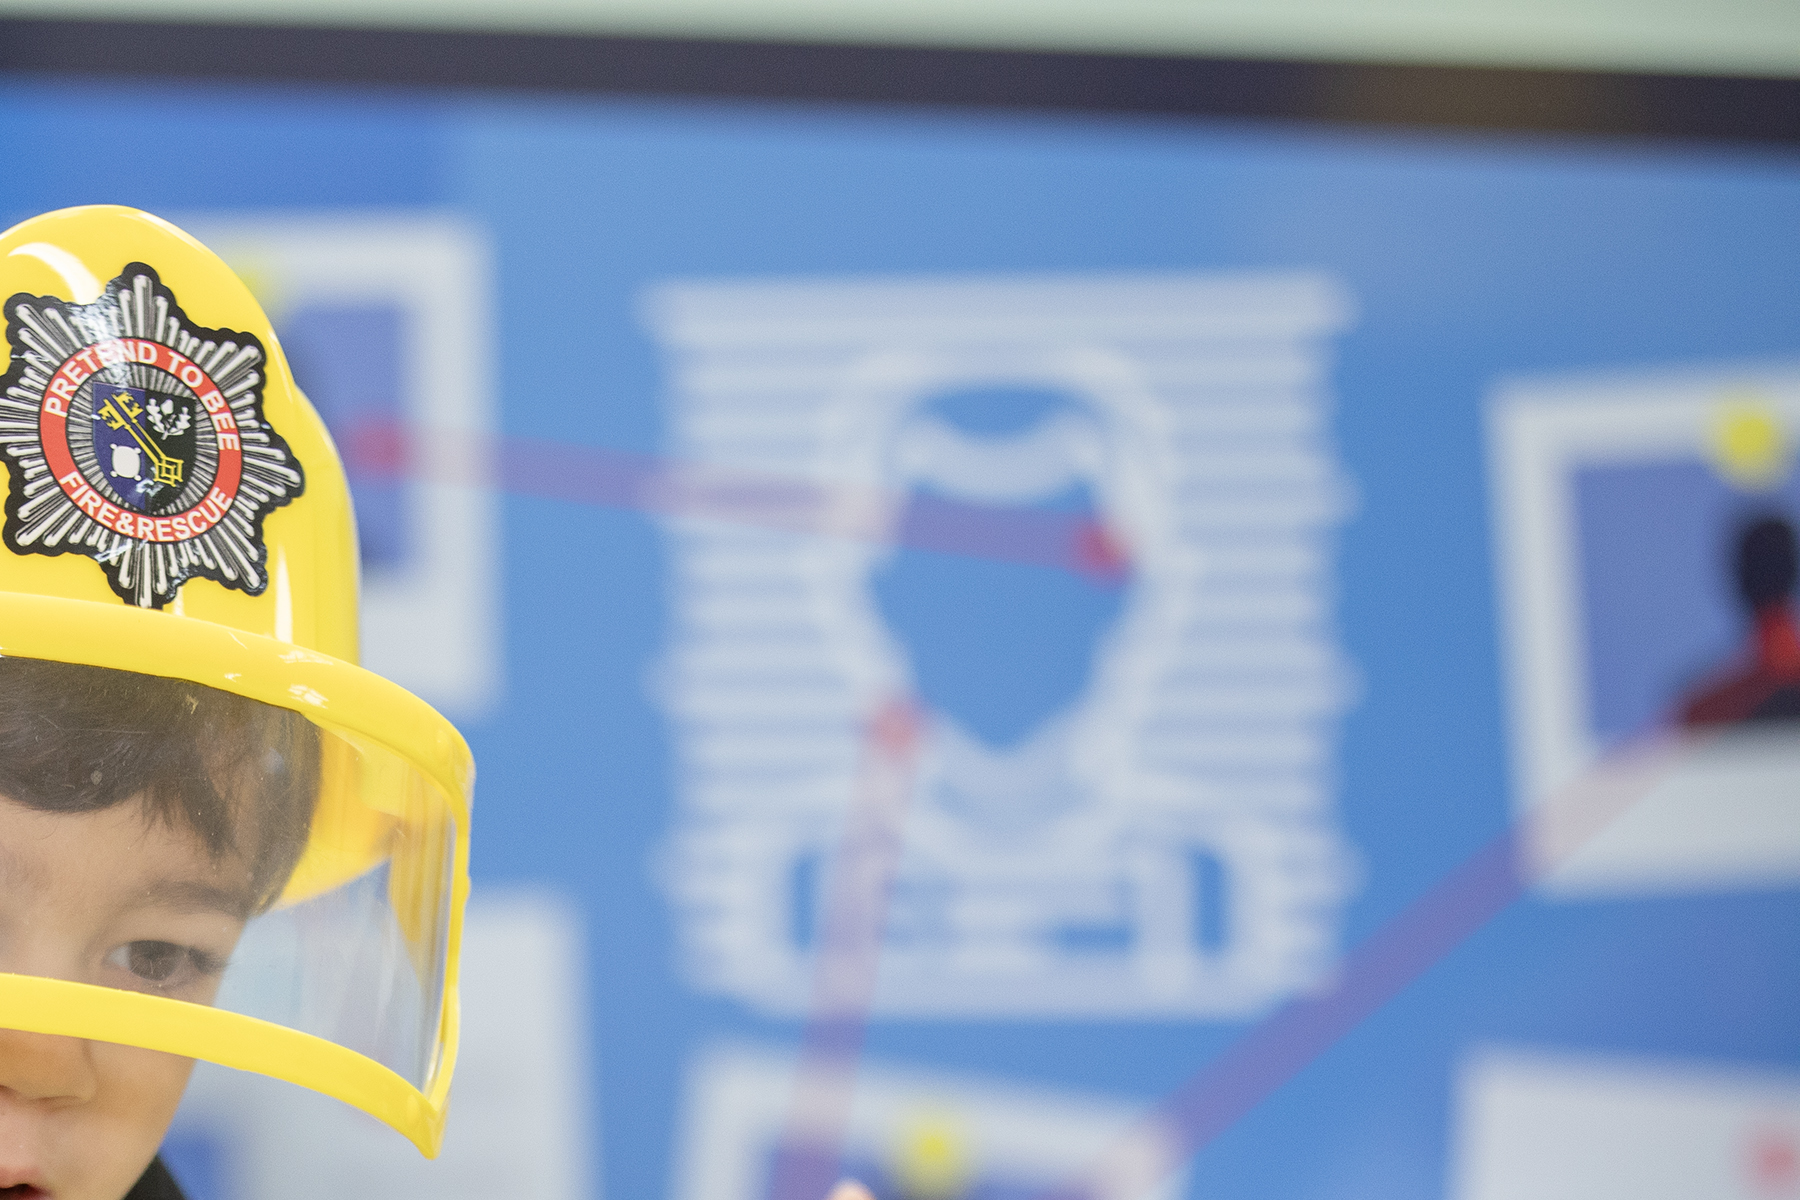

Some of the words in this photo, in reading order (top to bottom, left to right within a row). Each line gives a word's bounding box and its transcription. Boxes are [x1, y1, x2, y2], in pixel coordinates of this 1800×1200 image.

[44, 340, 158, 418] PRETEND
[166, 351, 204, 388] TO
[200, 390, 241, 451] BEE
